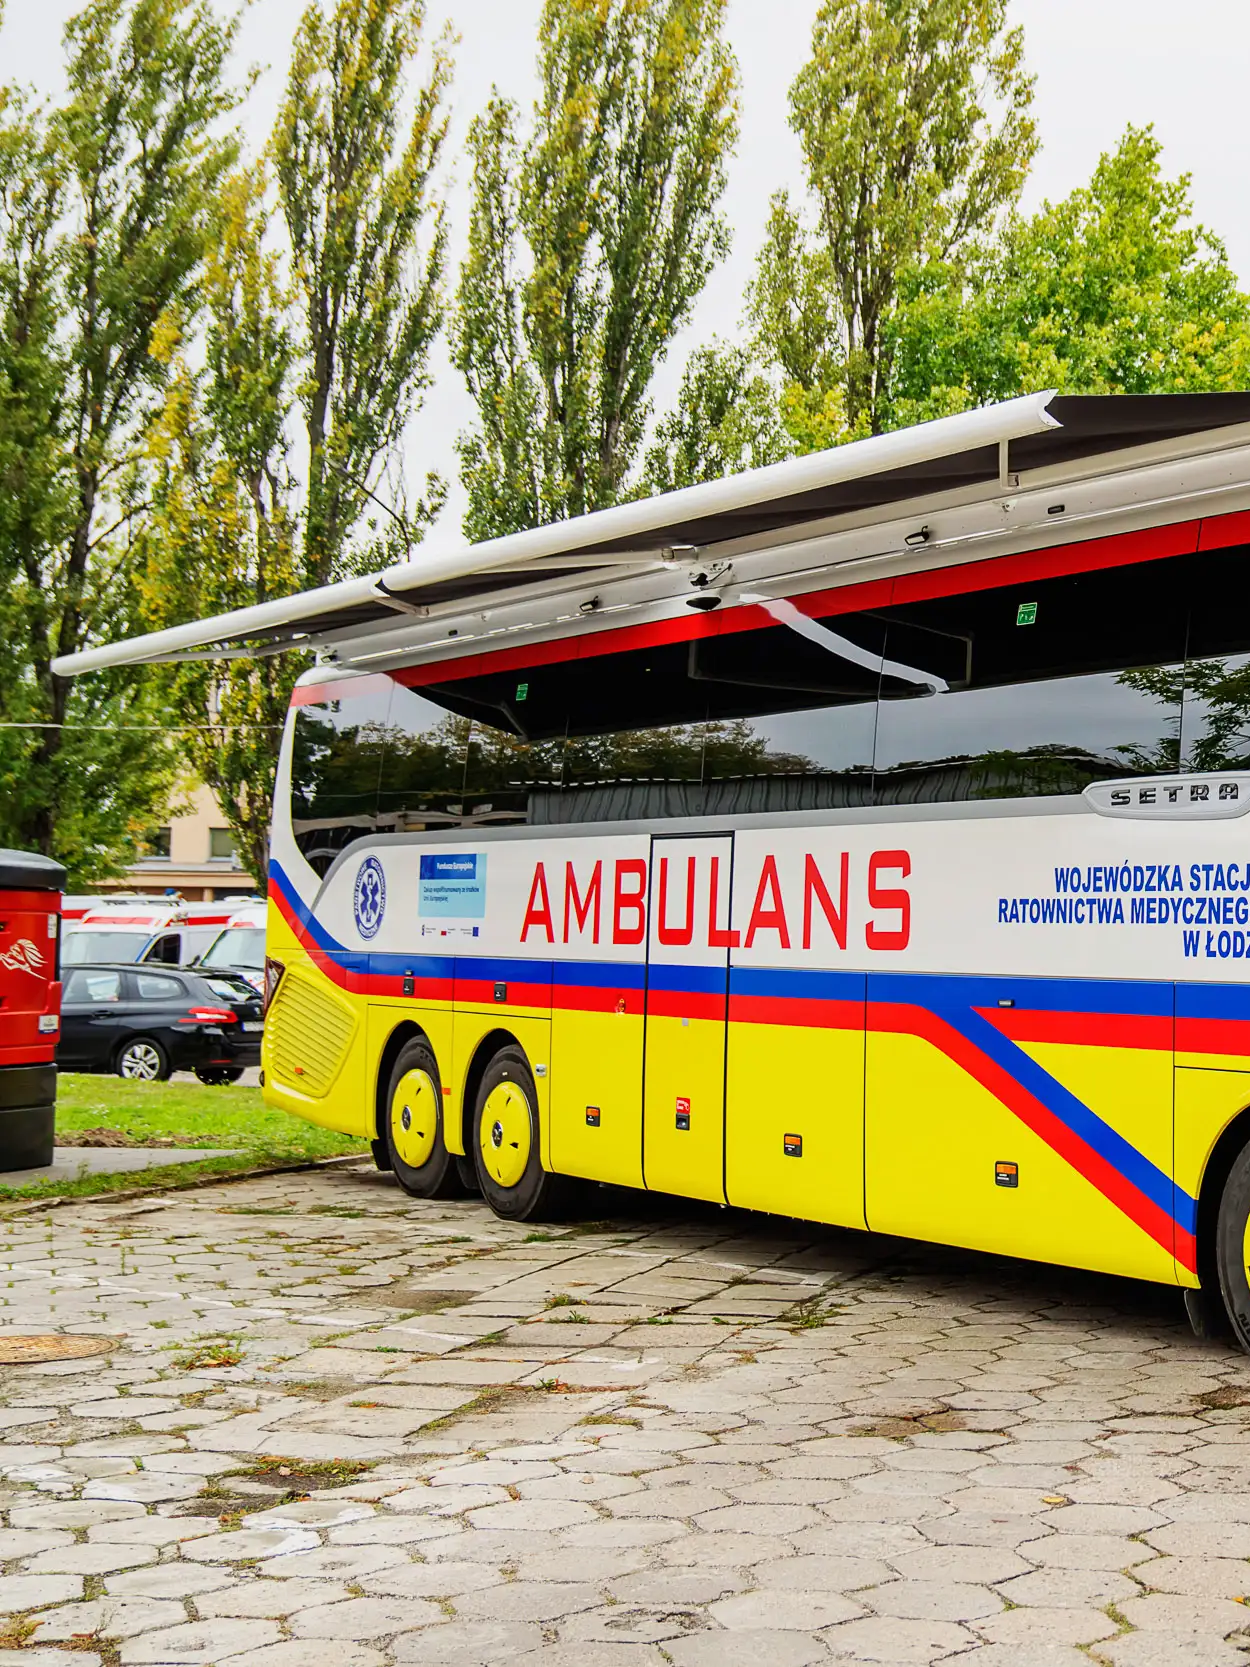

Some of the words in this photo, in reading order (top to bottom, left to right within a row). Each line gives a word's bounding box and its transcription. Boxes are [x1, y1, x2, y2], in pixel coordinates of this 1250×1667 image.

[1110, 782, 1240, 806] SETRA
[1054, 860, 1184, 893] WOJEWÓDZKA
[519, 849, 911, 951] AMBULANS
[998, 897, 1125, 924] RATOWNICTWA
[1183, 931, 1201, 958] W
